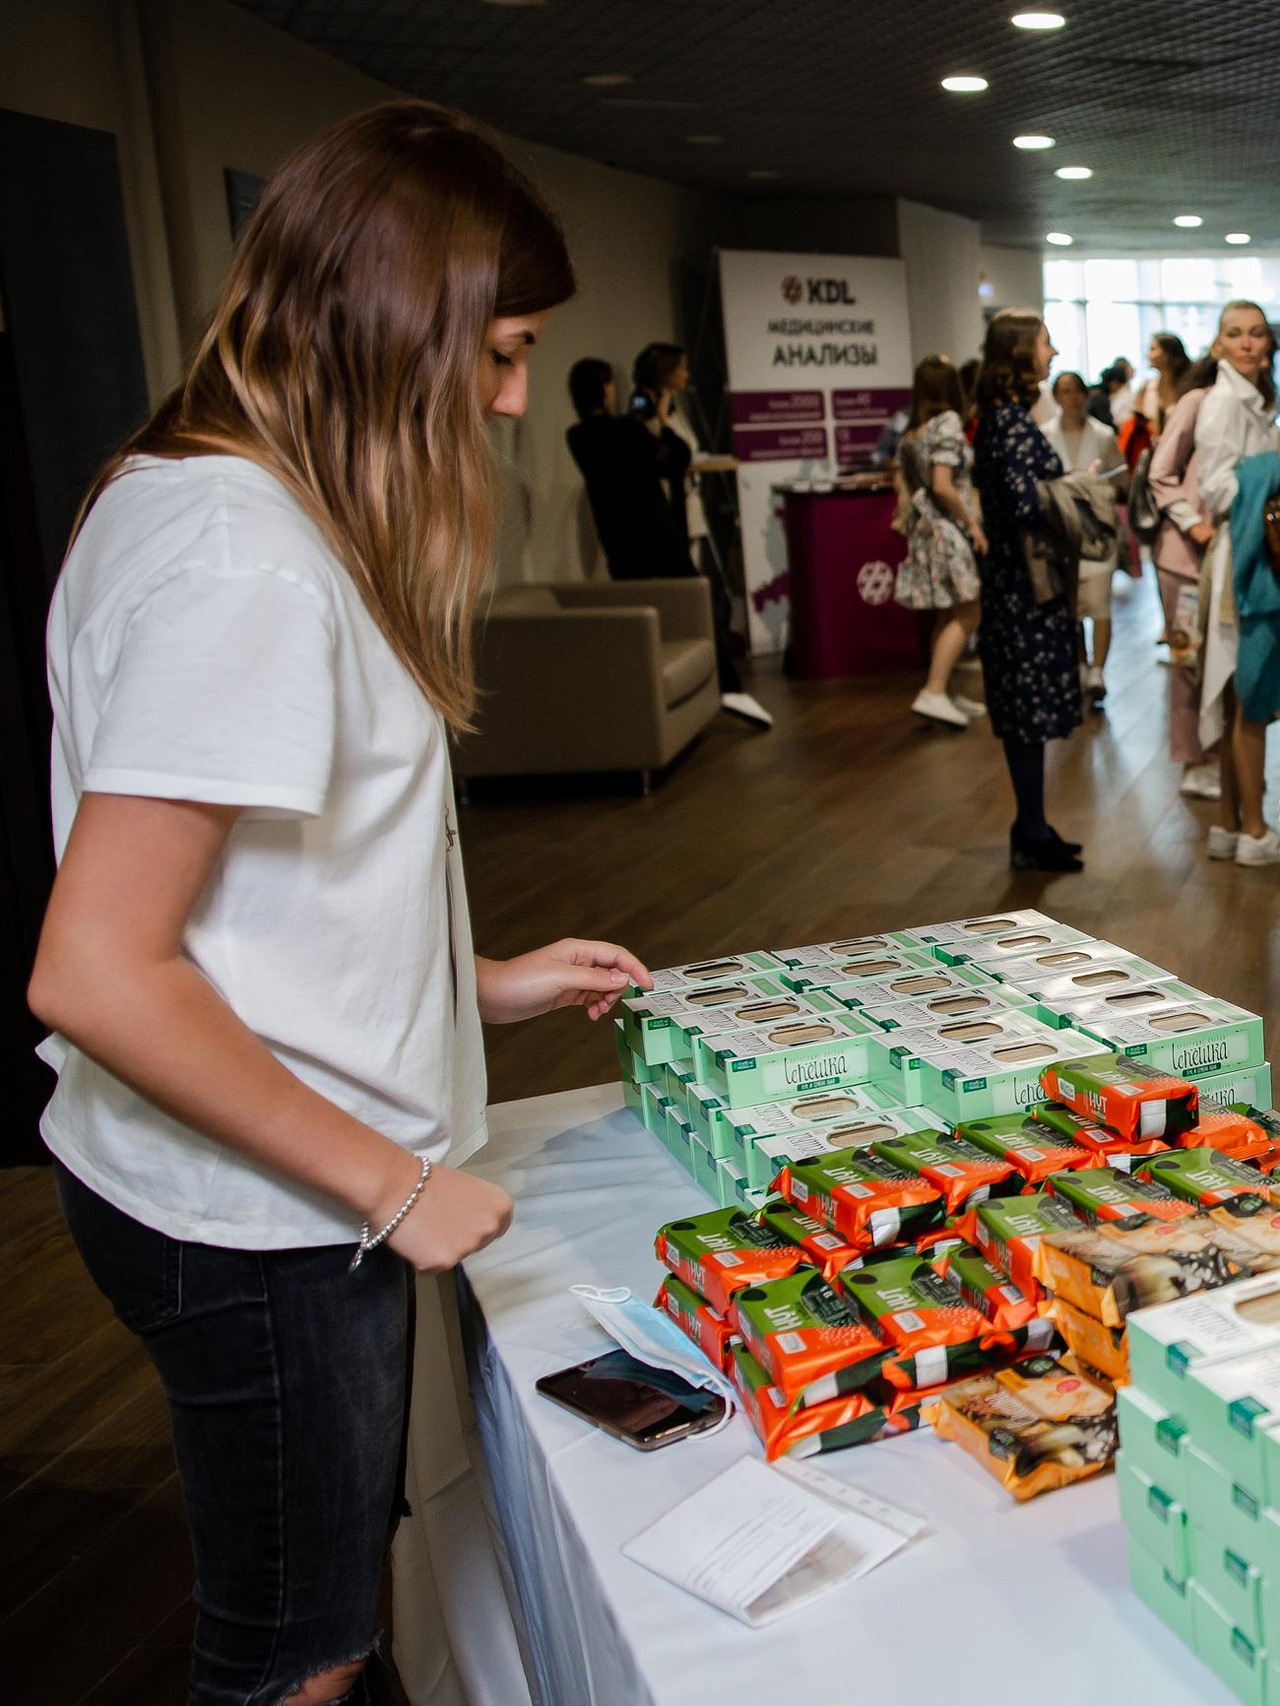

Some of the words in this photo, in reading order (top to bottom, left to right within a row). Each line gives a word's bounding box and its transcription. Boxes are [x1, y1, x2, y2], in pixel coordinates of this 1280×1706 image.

[807, 279, 855, 305] KDL
[772, 343, 878, 367] АНАЛИЗЫ
[1013, 1076, 1050, 1105] Лепё
[1089, 1090, 1108, 1113] НУТ
[994, 1133, 1034, 1149] НУТ
[909, 1148, 952, 1165] НУТ
[822, 1166, 864, 1184] НУТ
[1185, 1169, 1230, 1189] НУТ
[1086, 1185, 1131, 1204] НУТ
[1004, 1214, 1046, 1236] НУТ
[696, 1233, 736, 1252] НУТ
[876, 1286, 918, 1312] НУТ
[764, 1304, 803, 1332] НУТ
